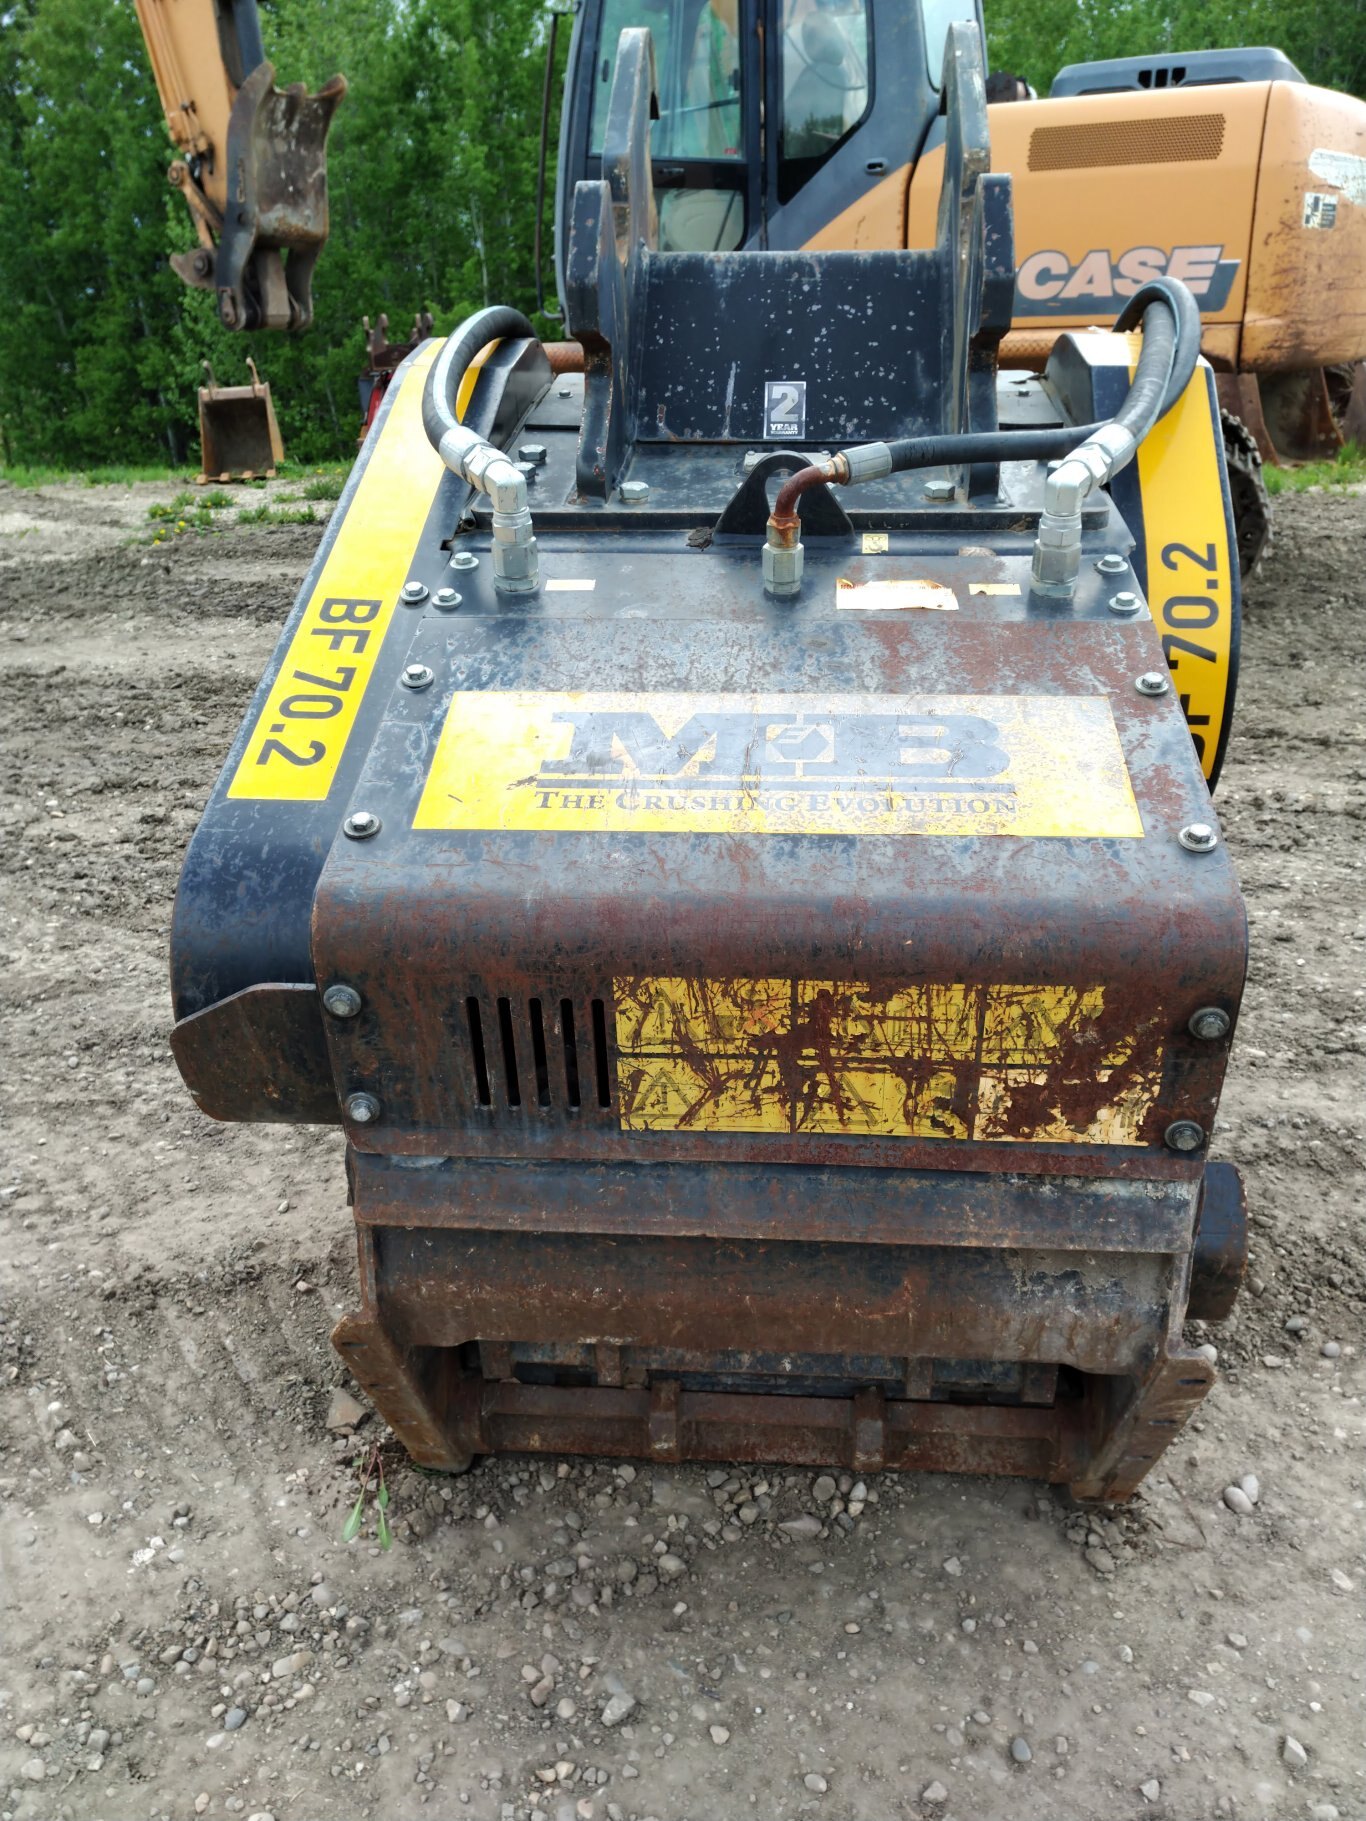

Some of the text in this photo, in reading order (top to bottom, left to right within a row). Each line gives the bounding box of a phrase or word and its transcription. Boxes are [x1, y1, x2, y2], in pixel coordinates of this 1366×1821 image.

[1016, 244, 1224, 301] CASE
[771, 385, 799, 422] 2
[1161, 542, 1219, 670] 70.2
[256, 598, 383, 766] BF 70.2
[540, 711, 1011, 778] MB
[534, 790, 1017, 815] THE CRUSHING EVOLUTION
